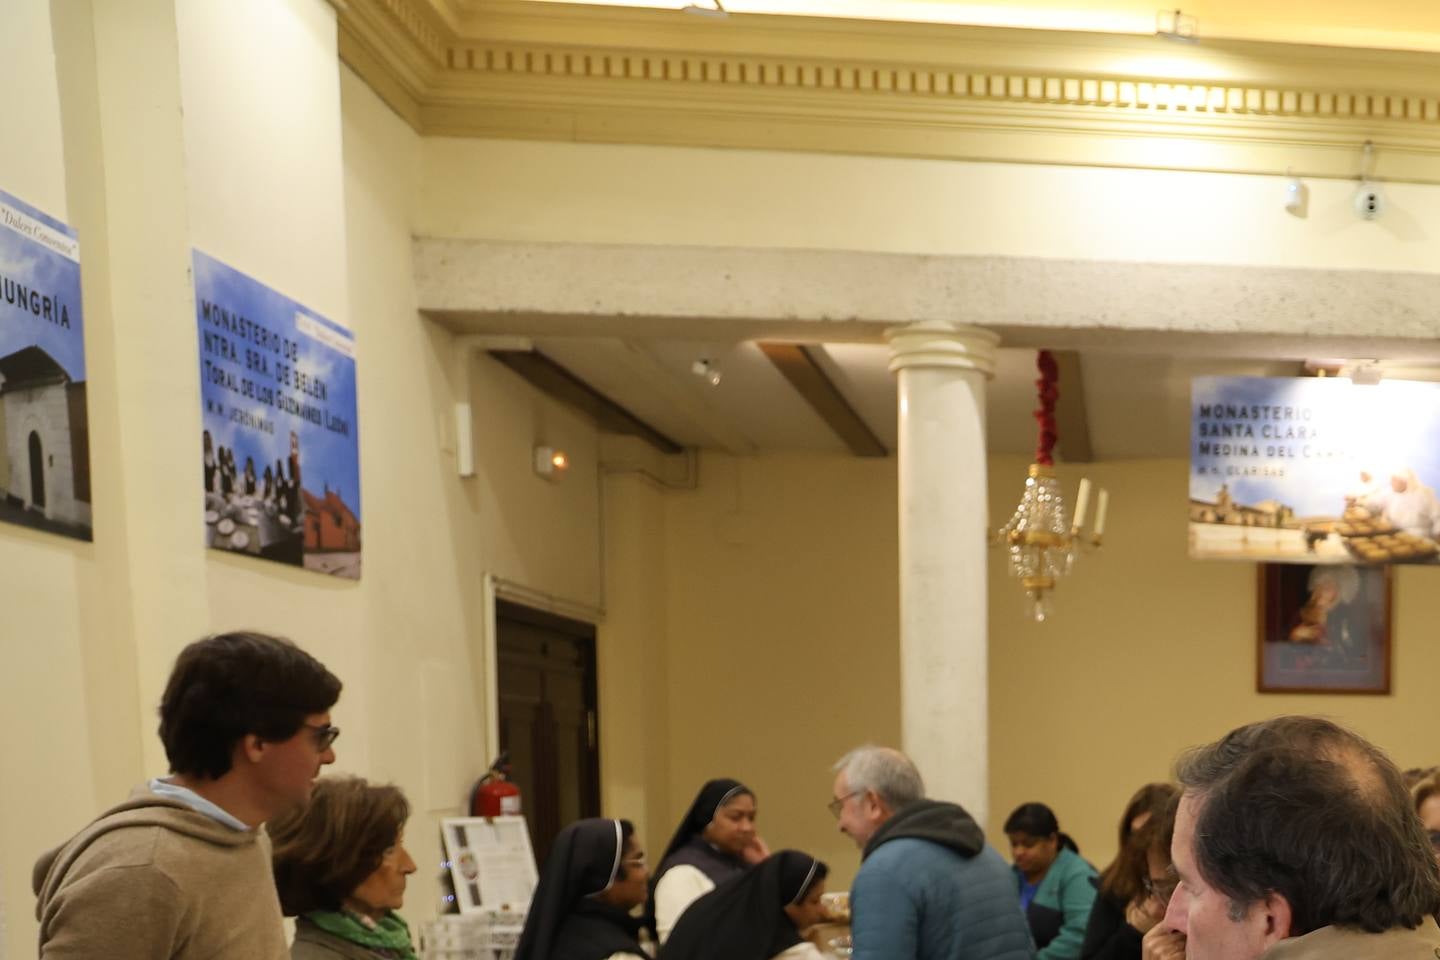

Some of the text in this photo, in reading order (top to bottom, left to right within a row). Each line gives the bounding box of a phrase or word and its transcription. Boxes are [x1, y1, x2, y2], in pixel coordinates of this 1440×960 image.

[202, 298, 281, 354] MONASTERIO
[284, 337, 298, 363] DE
[205, 359, 239, 392] TORAL
[242, 378, 254, 399] DE
[256, 385, 274, 407] LOS
[276, 361, 290, 387] DE
[1199, 403, 1312, 421] MONASTERIO
[1199, 422, 1318, 439] SANTA CLARA
[1199, 440, 1259, 457] MEDINA
[1266, 445, 1296, 459] DEL
